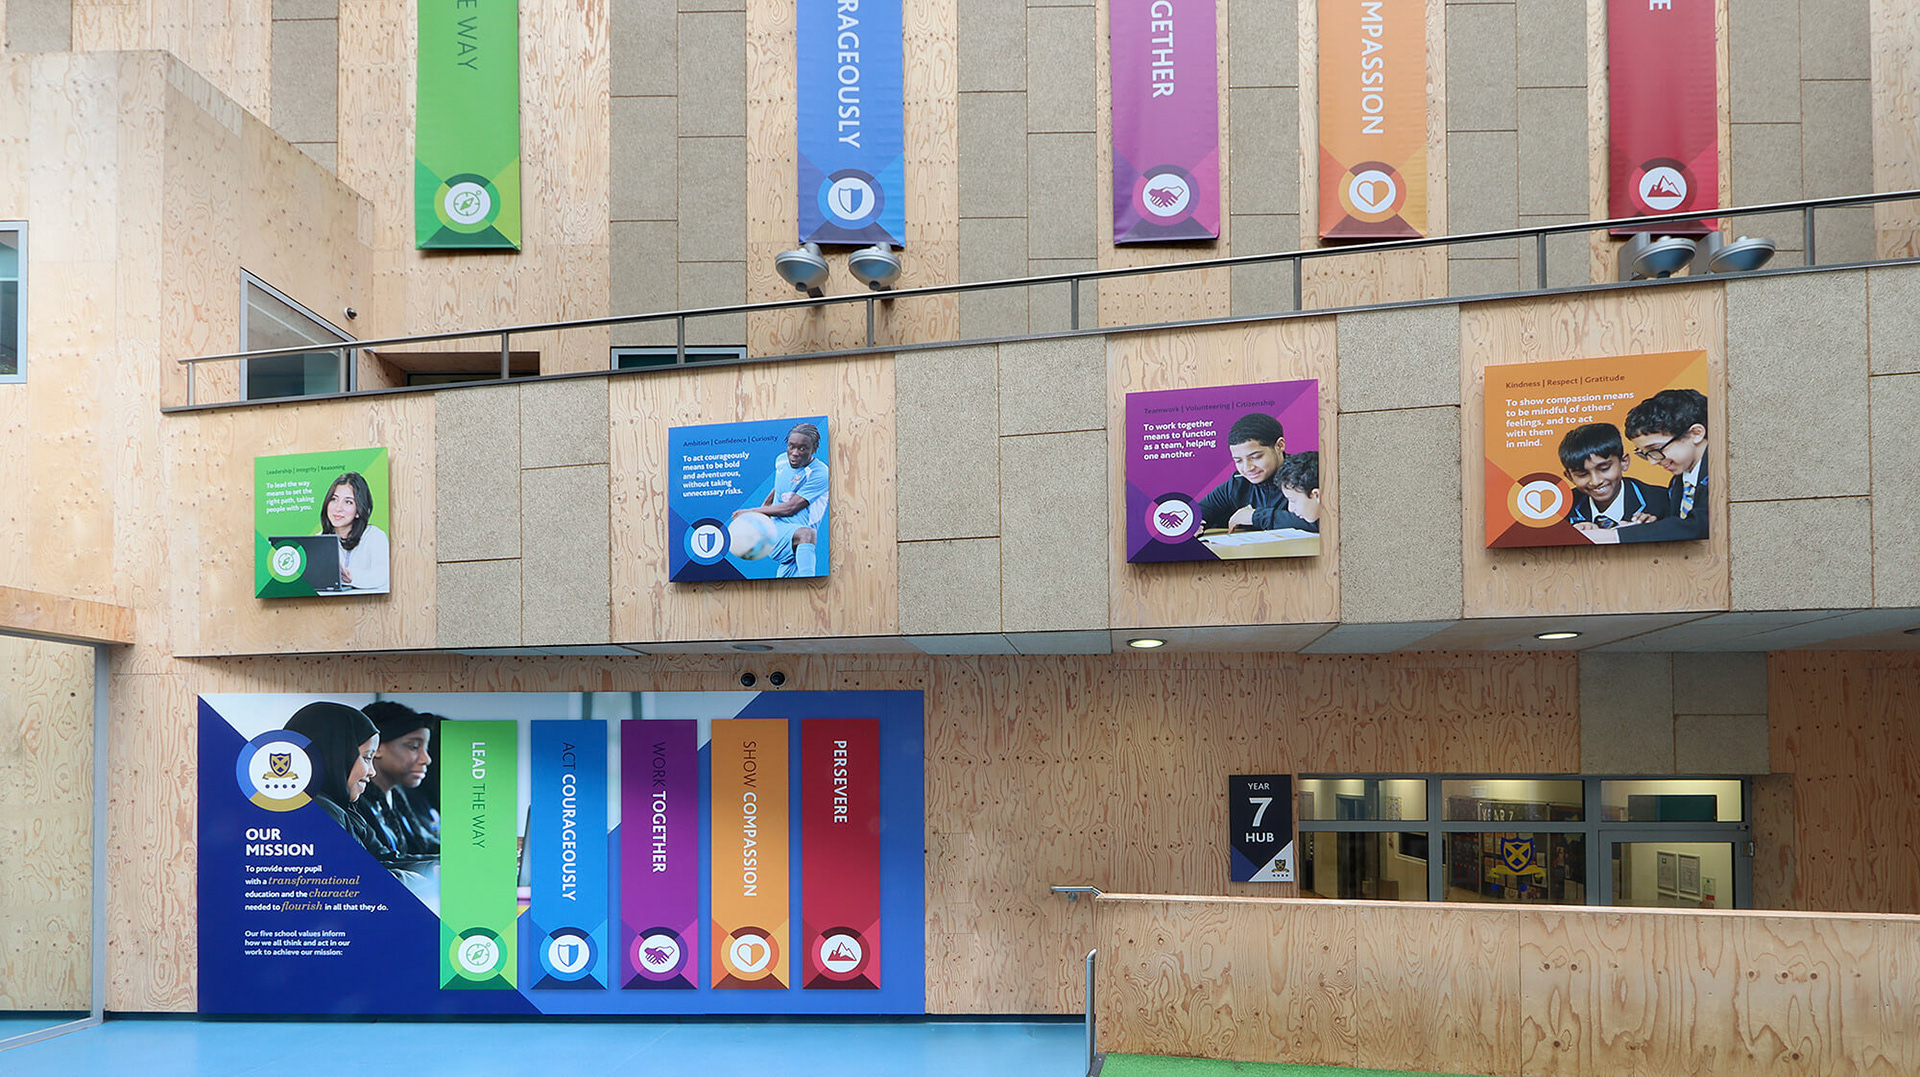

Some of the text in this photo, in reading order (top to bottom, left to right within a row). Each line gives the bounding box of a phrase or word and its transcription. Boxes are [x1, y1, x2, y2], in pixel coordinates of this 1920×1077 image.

[457, 16, 478, 70] WAY
[1506, 381, 1540, 389] Kindness
[1547, 378, 1578, 387] Respect
[1585, 374, 1625, 383] Gratitude
[1520, 397, 1544, 406] show
[1546, 394, 1601, 404] compassion
[1603, 392, 1634, 400] means
[1144, 406, 1179, 414] Teamwork
[1185, 403, 1230, 411] Volunteering
[1236, 399, 1275, 408] Citizenship
[1518, 408, 1529, 416] be
[1531, 406, 1567, 415] mindful
[1569, 405, 1580, 413] of
[1156, 422, 1176, 430] work
[1178, 420, 1213, 430] together
[1506, 418, 1544, 428] feelings,
[1546, 416, 1564, 425] and
[1578, 415, 1593, 423] act
[1144, 430, 1216, 441] means to function
[1506, 428, 1554, 437] with them
[1161, 442, 1184, 450] team,
[1186, 439, 1216, 448] helping
[1506, 439, 1543, 448] in mind.
[705, 451, 750, 461] courageously
[1160, 451, 1196, 459] another.
[683, 471, 741, 480] and adventurous,
[266, 506, 285, 514] people
[832, 741, 849, 824] PERSEVERE
[472, 742, 486, 848] LEAD THE WAY
[652, 742, 667, 873] WORK TOGETHER
[1249, 797, 1273, 827] 7
[562, 742, 576, 901] ACT COURAGEOUSLY
[743, 741, 757, 897] SHOW COMPASSION
[1508, 811, 1514, 821] 7
[245, 828, 281, 841] OUR
[1245, 832, 1275, 843] HUB
[245, 844, 314, 856] MISSION
[256, 865, 282, 874] provide
[283, 866, 303, 874] every
[304, 865, 322, 874] pupil
[268, 876, 360, 886] transformational
[245, 888, 360, 898] education and the character
[245, 903, 272, 911] needed
[281, 901, 323, 912] flourish
[343, 903, 358, 911] that
[359, 903, 376, 912] they
[377, 903, 388, 911] do.
